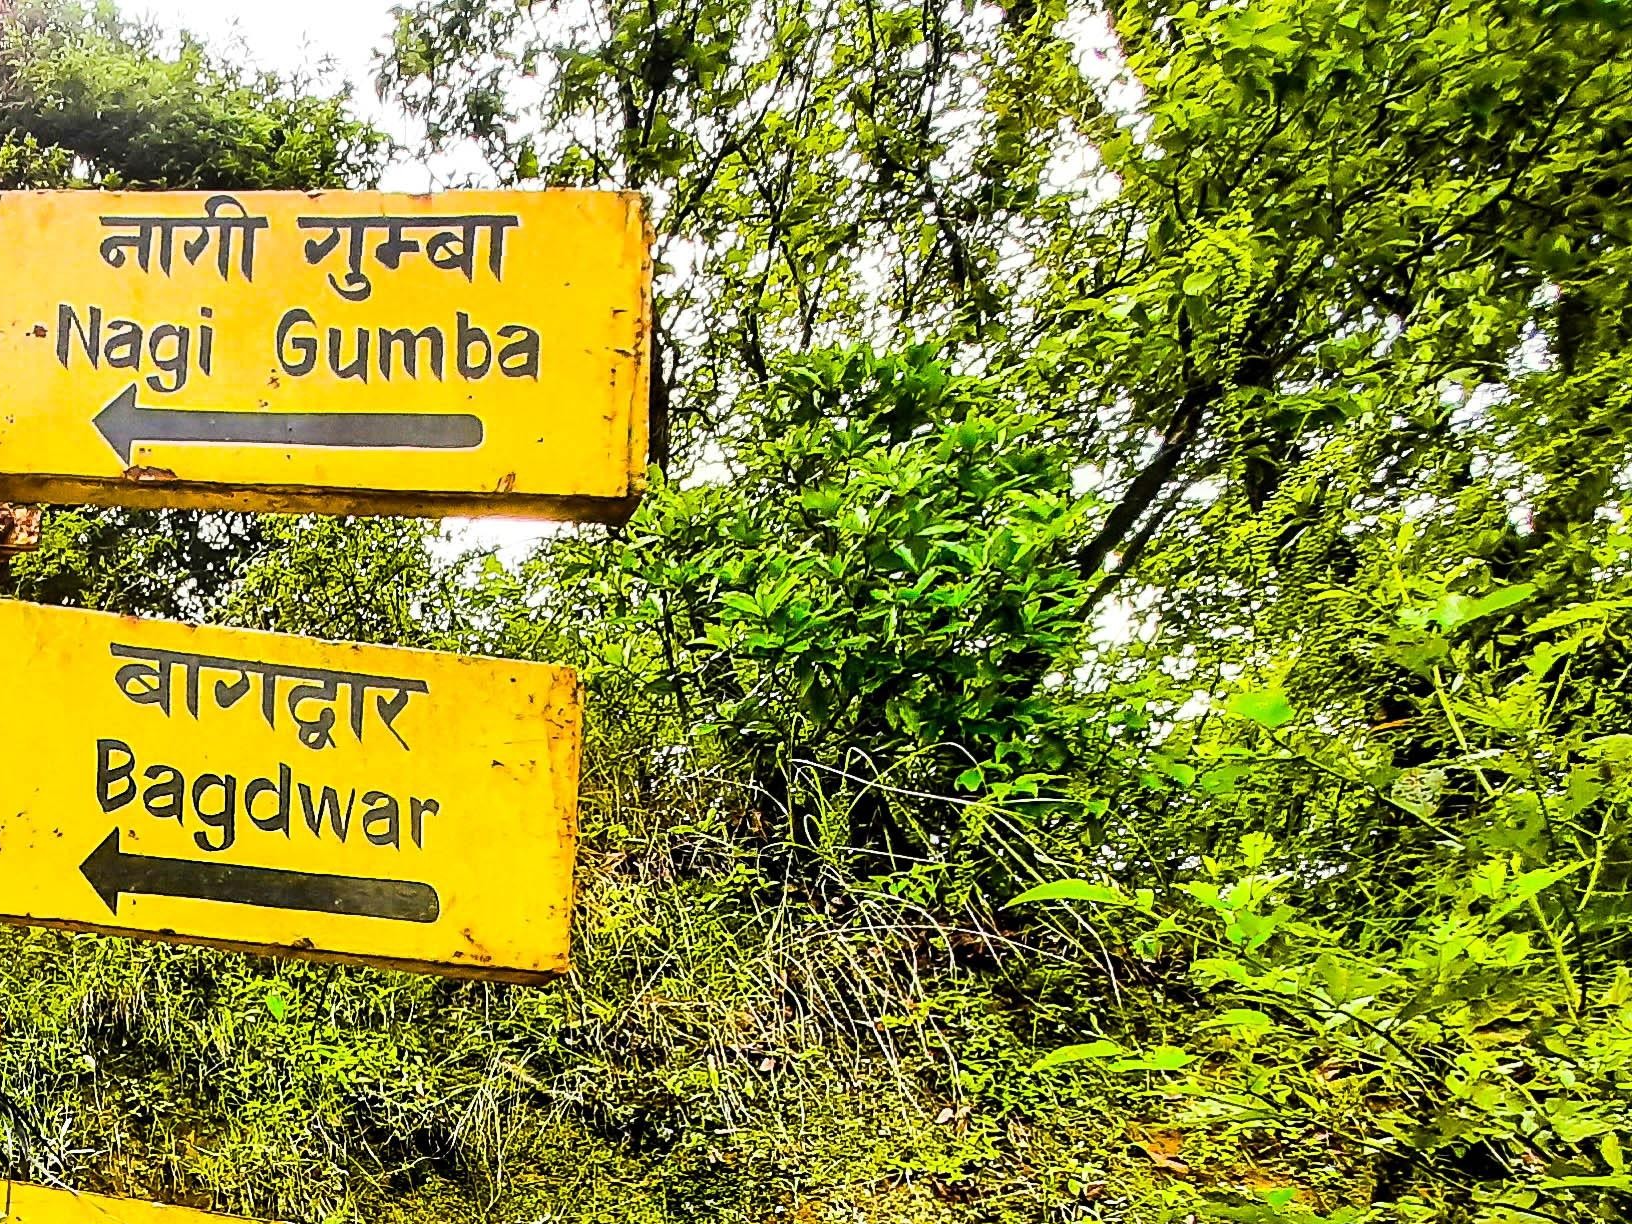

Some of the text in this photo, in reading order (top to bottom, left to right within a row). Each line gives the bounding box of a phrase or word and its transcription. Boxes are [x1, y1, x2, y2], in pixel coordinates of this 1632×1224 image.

[99, 194, 519, 301] नागी गुम्बा
[56, 303, 540, 393] Nagi Gumba
[109, 642, 429, 751] बागद्वार
[96, 739, 440, 852] Bagdwar
